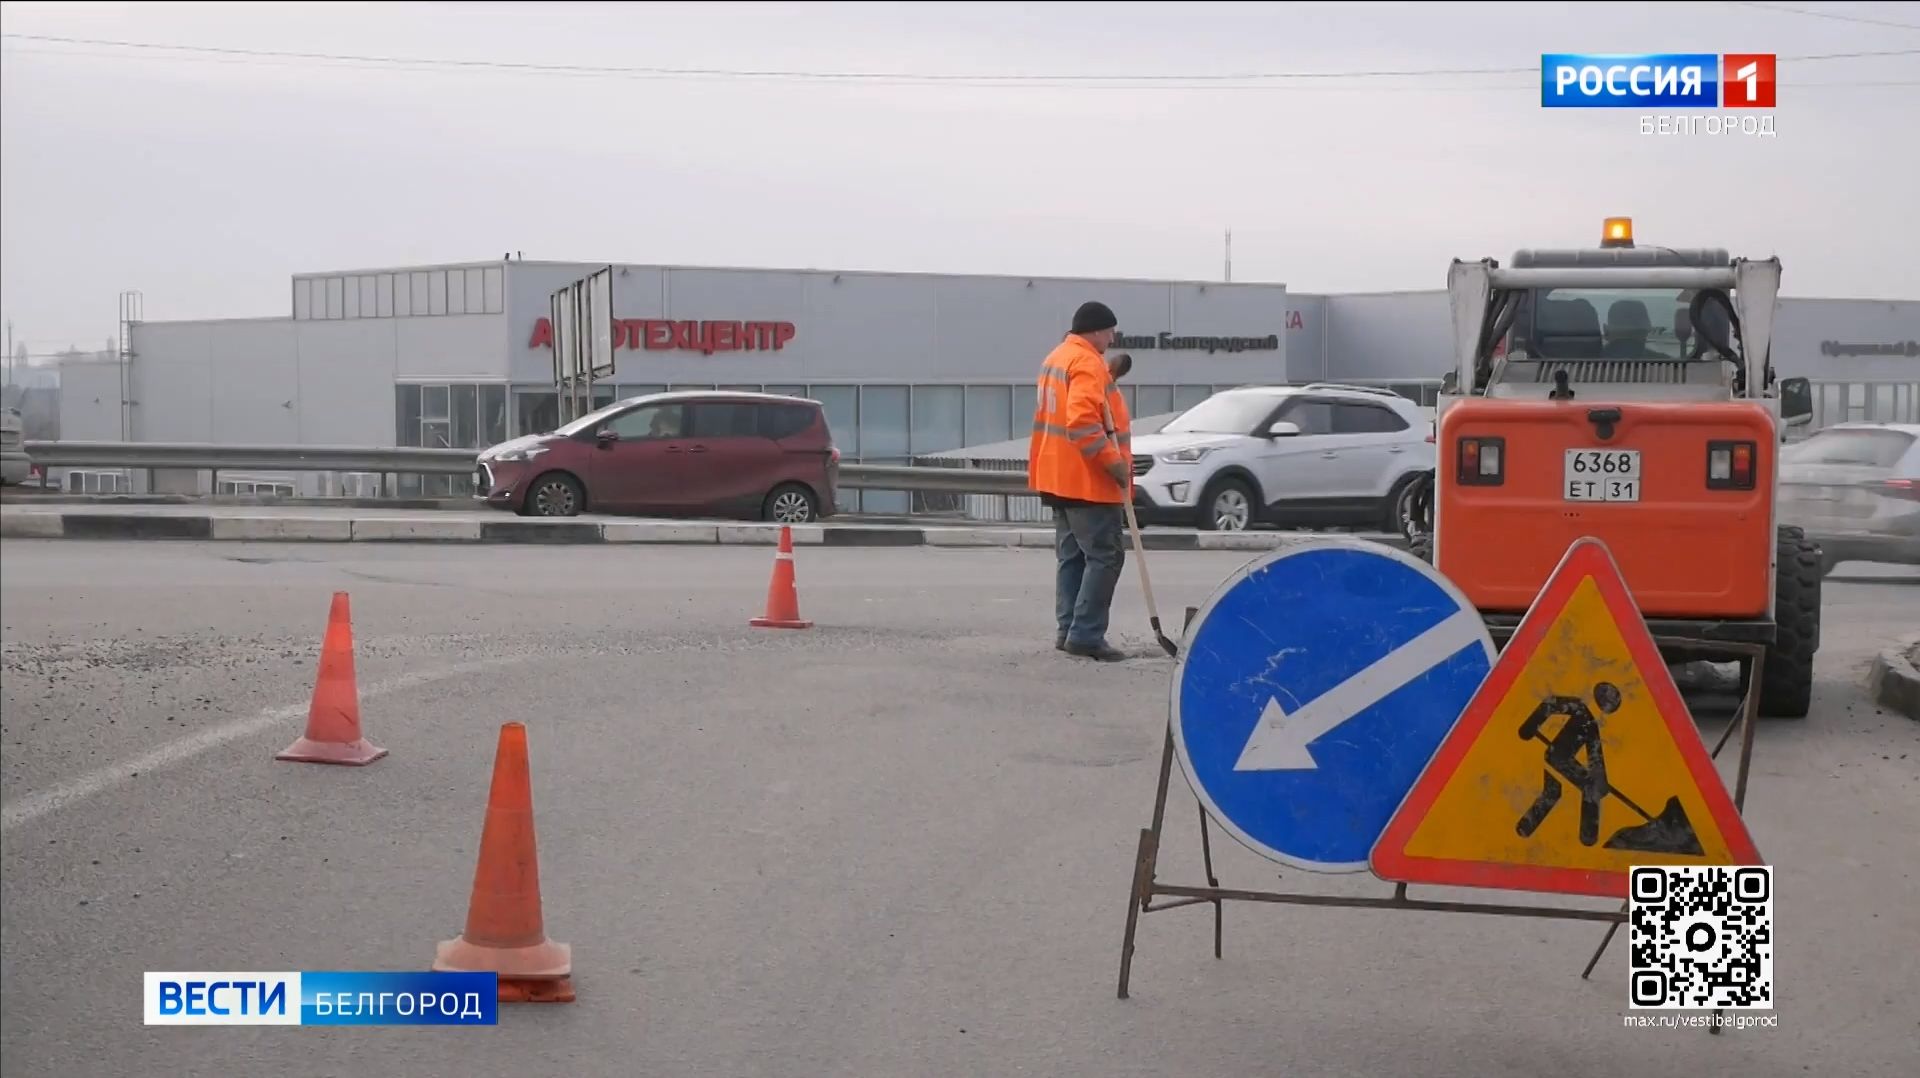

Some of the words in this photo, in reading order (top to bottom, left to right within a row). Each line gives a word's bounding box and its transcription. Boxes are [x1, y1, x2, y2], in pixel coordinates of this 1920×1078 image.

[528, 317, 796, 355] АОТЕХЦЕНТР
[1159, 332, 1279, 354] Белгородский
[1573, 452, 1631, 473] 6368
[1569, 481, 1596, 498] ЕТ
[1611, 482, 1633, 499] 31
